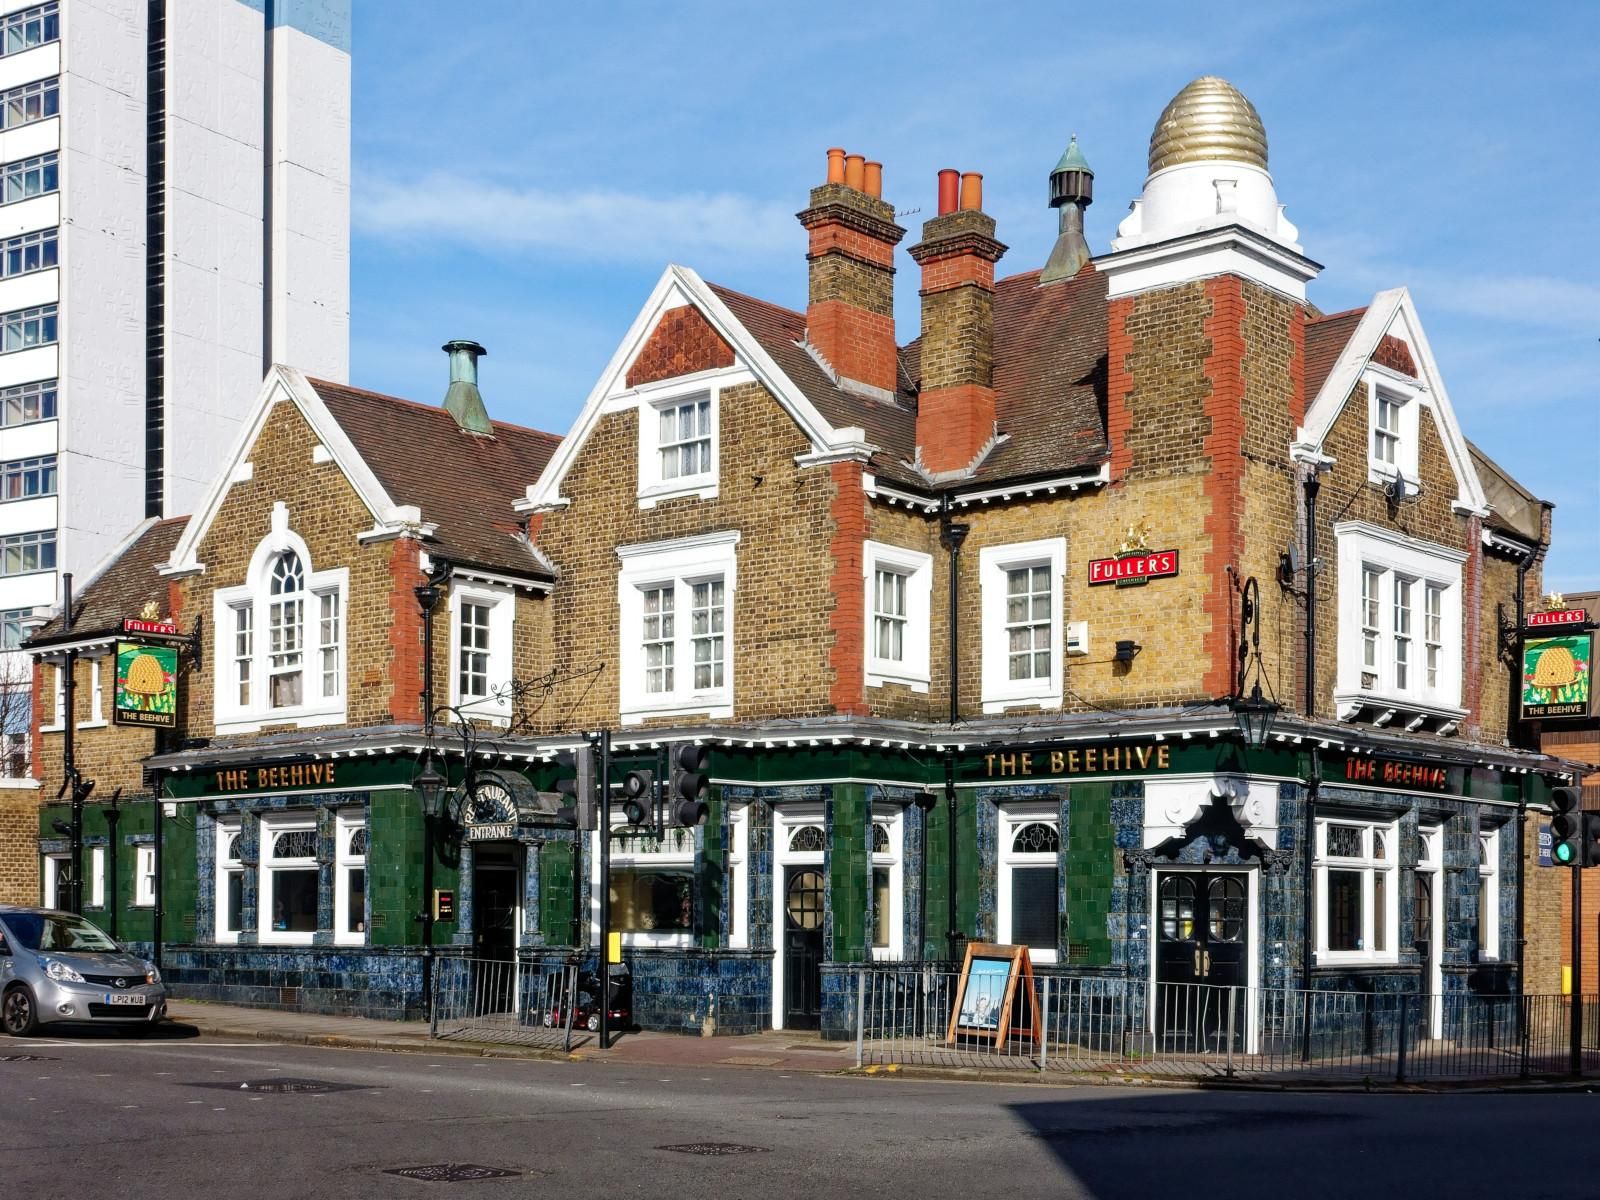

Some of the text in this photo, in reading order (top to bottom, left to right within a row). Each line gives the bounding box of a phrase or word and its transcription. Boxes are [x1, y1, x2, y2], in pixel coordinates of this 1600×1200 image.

[1093, 555, 1170, 580] FULLER'S
[1530, 611, 1581, 624] FULLER'S
[121, 711, 170, 723] THE BEEHIVE
[1528, 704, 1582, 716] THE BEEHIVE
[985, 745, 1170, 776] THE BEEHIVE
[216, 762, 335, 791] THE BEEHIVE
[1346, 757, 1446, 789] THE BEEHIVE
[464, 785, 518, 824] RETAURANT
[470, 825, 513, 840] ENTRANCE
[112, 995, 129, 1004] LP12
